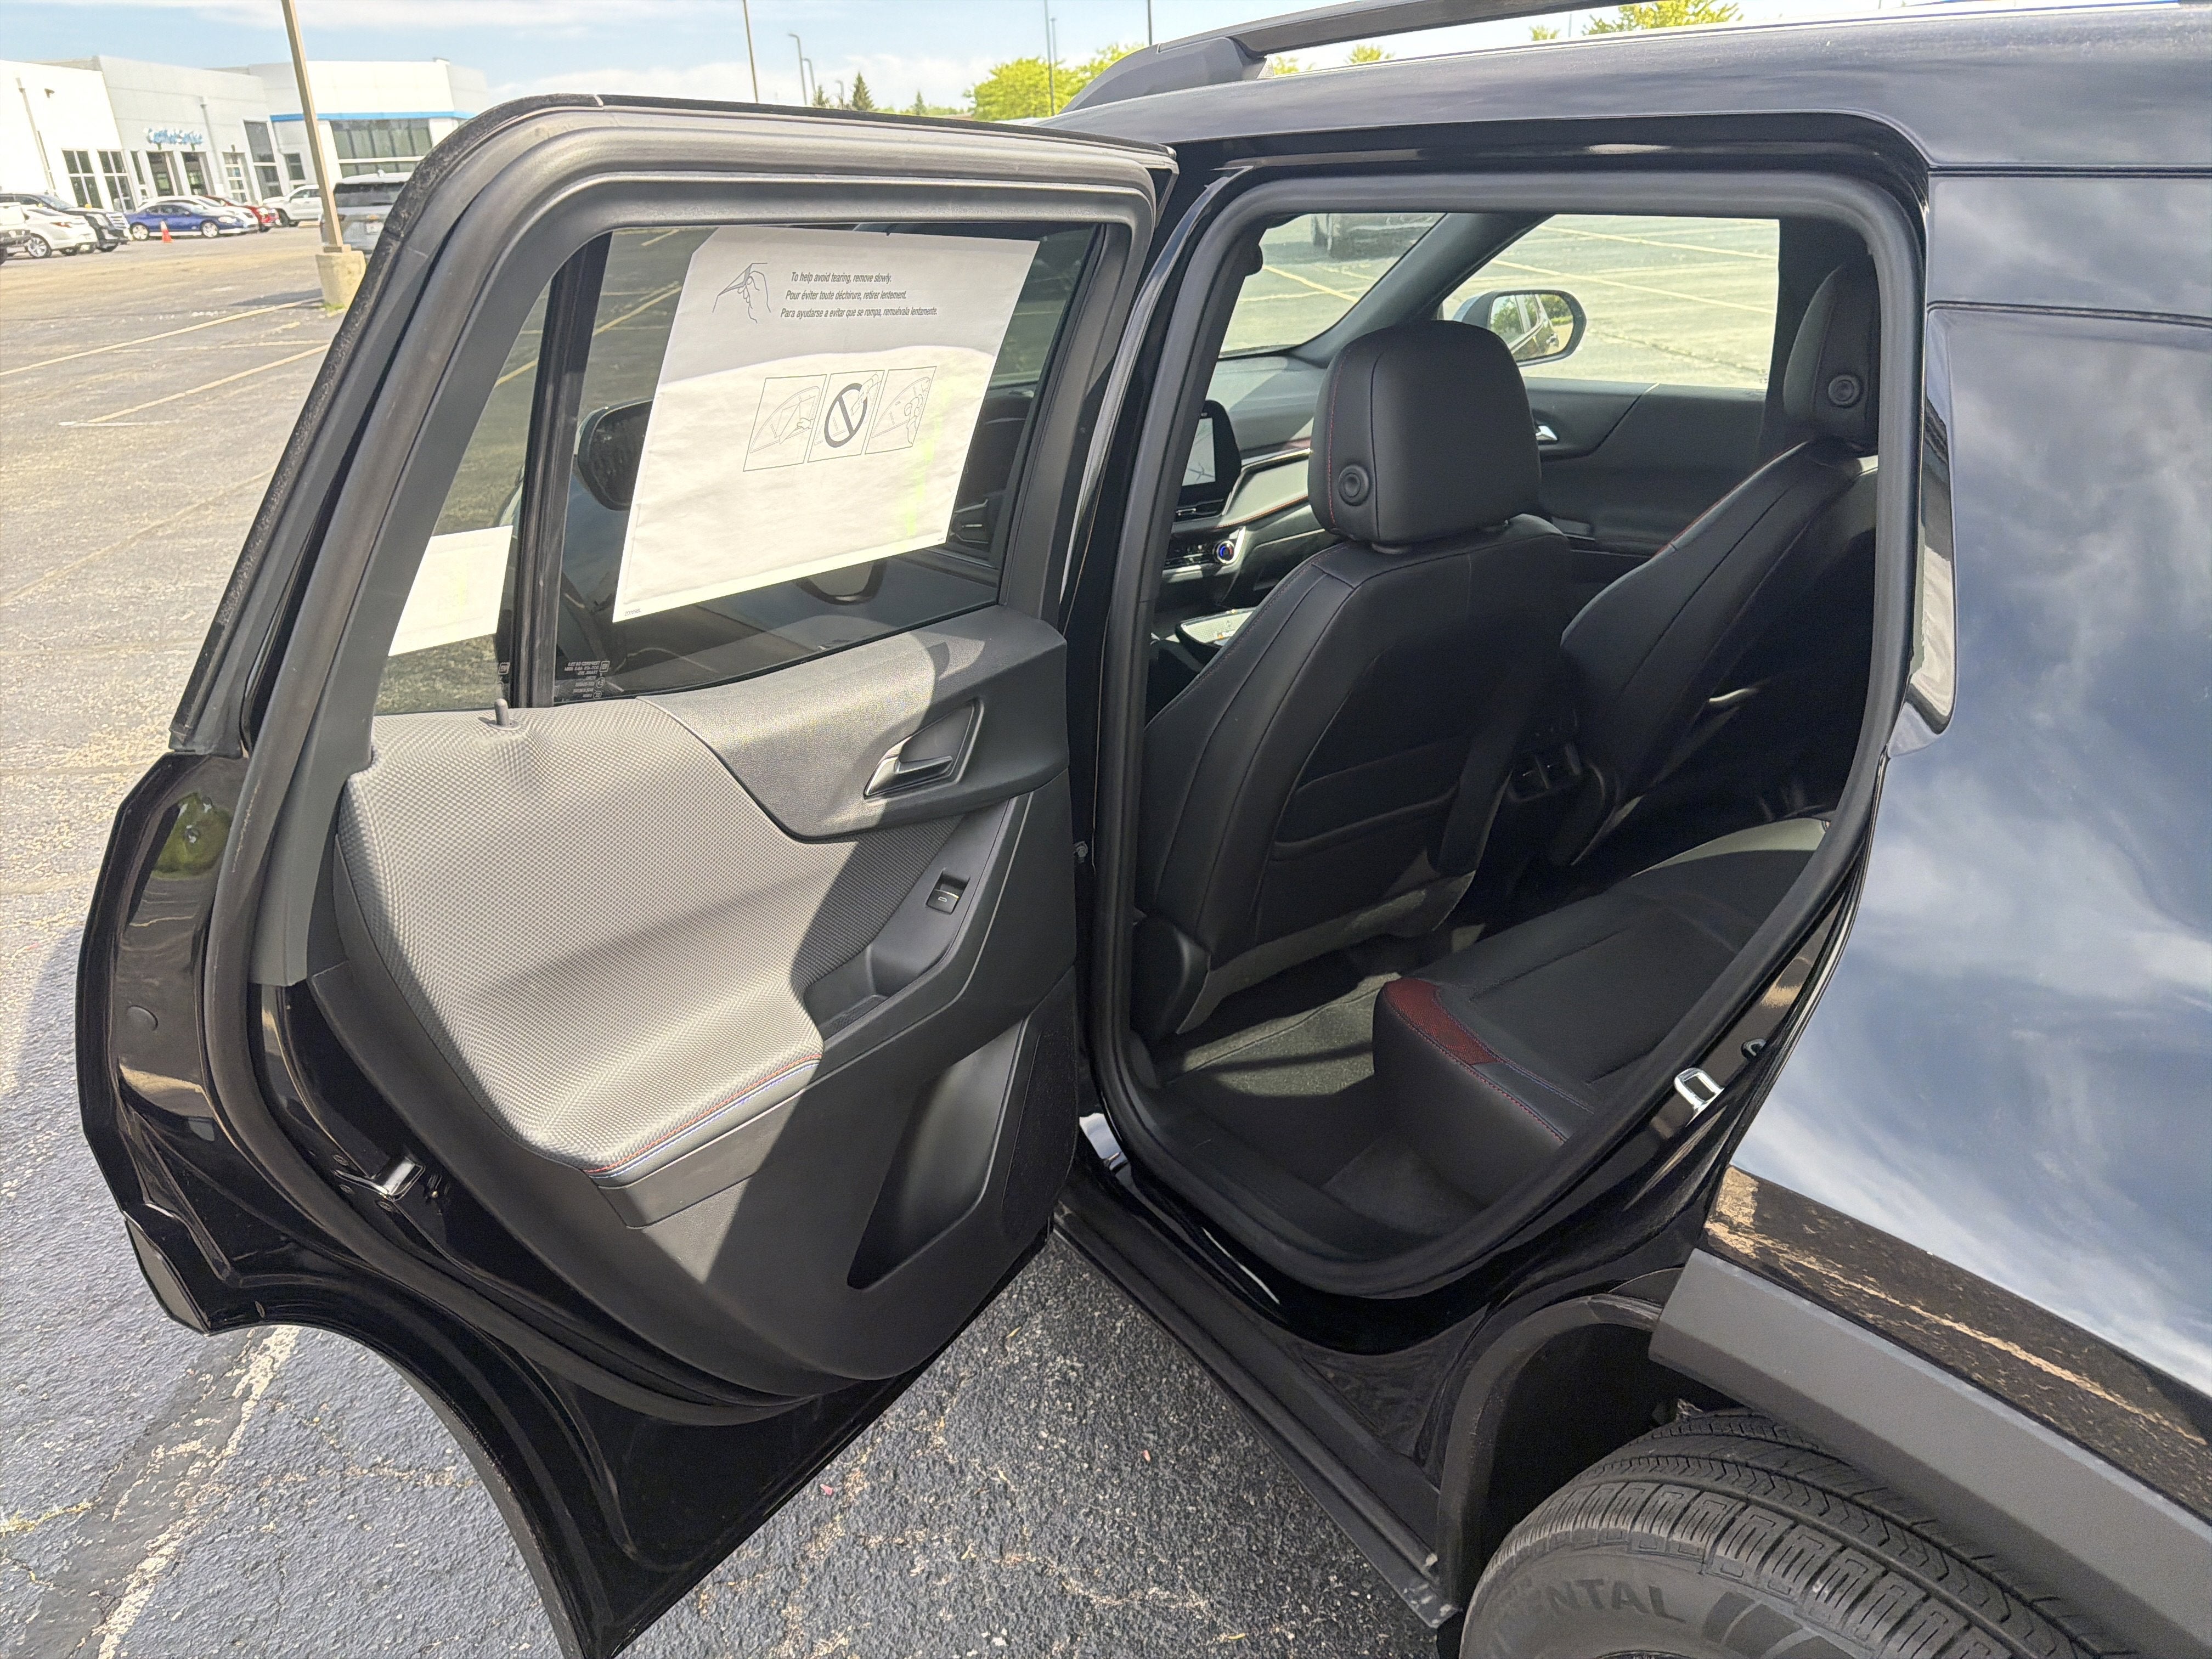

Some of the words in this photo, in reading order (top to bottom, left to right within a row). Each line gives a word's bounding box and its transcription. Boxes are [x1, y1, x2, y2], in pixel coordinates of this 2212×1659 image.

[791, 272, 799, 282] To
[799, 272, 813, 284] help
[814, 272, 831, 283] avoid
[831, 272, 851, 284] tearing,
[853, 274, 873, 283] remove
[873, 273, 891, 284] slowly.
[785, 290, 801, 300] Pour
[801, 289, 819, 300] éviter
[819, 290, 834, 300] toute
[835, 290, 862, 301] déchirure,
[863, 290, 880, 300] retirer
[880, 290, 907, 300] lentement.
[780, 308, 795, 318] Para
[796, 308, 823, 320] ayudarse
[824, 309, 829, 318] a
[829, 308, 845, 318] evitar
[847, 309, 856, 319] que
[856, 308, 864, 317] se
[864, 308, 882, 318] rompa,
[883, 306, 910, 316] remuévala
[910, 306, 938, 316] lentamente.
